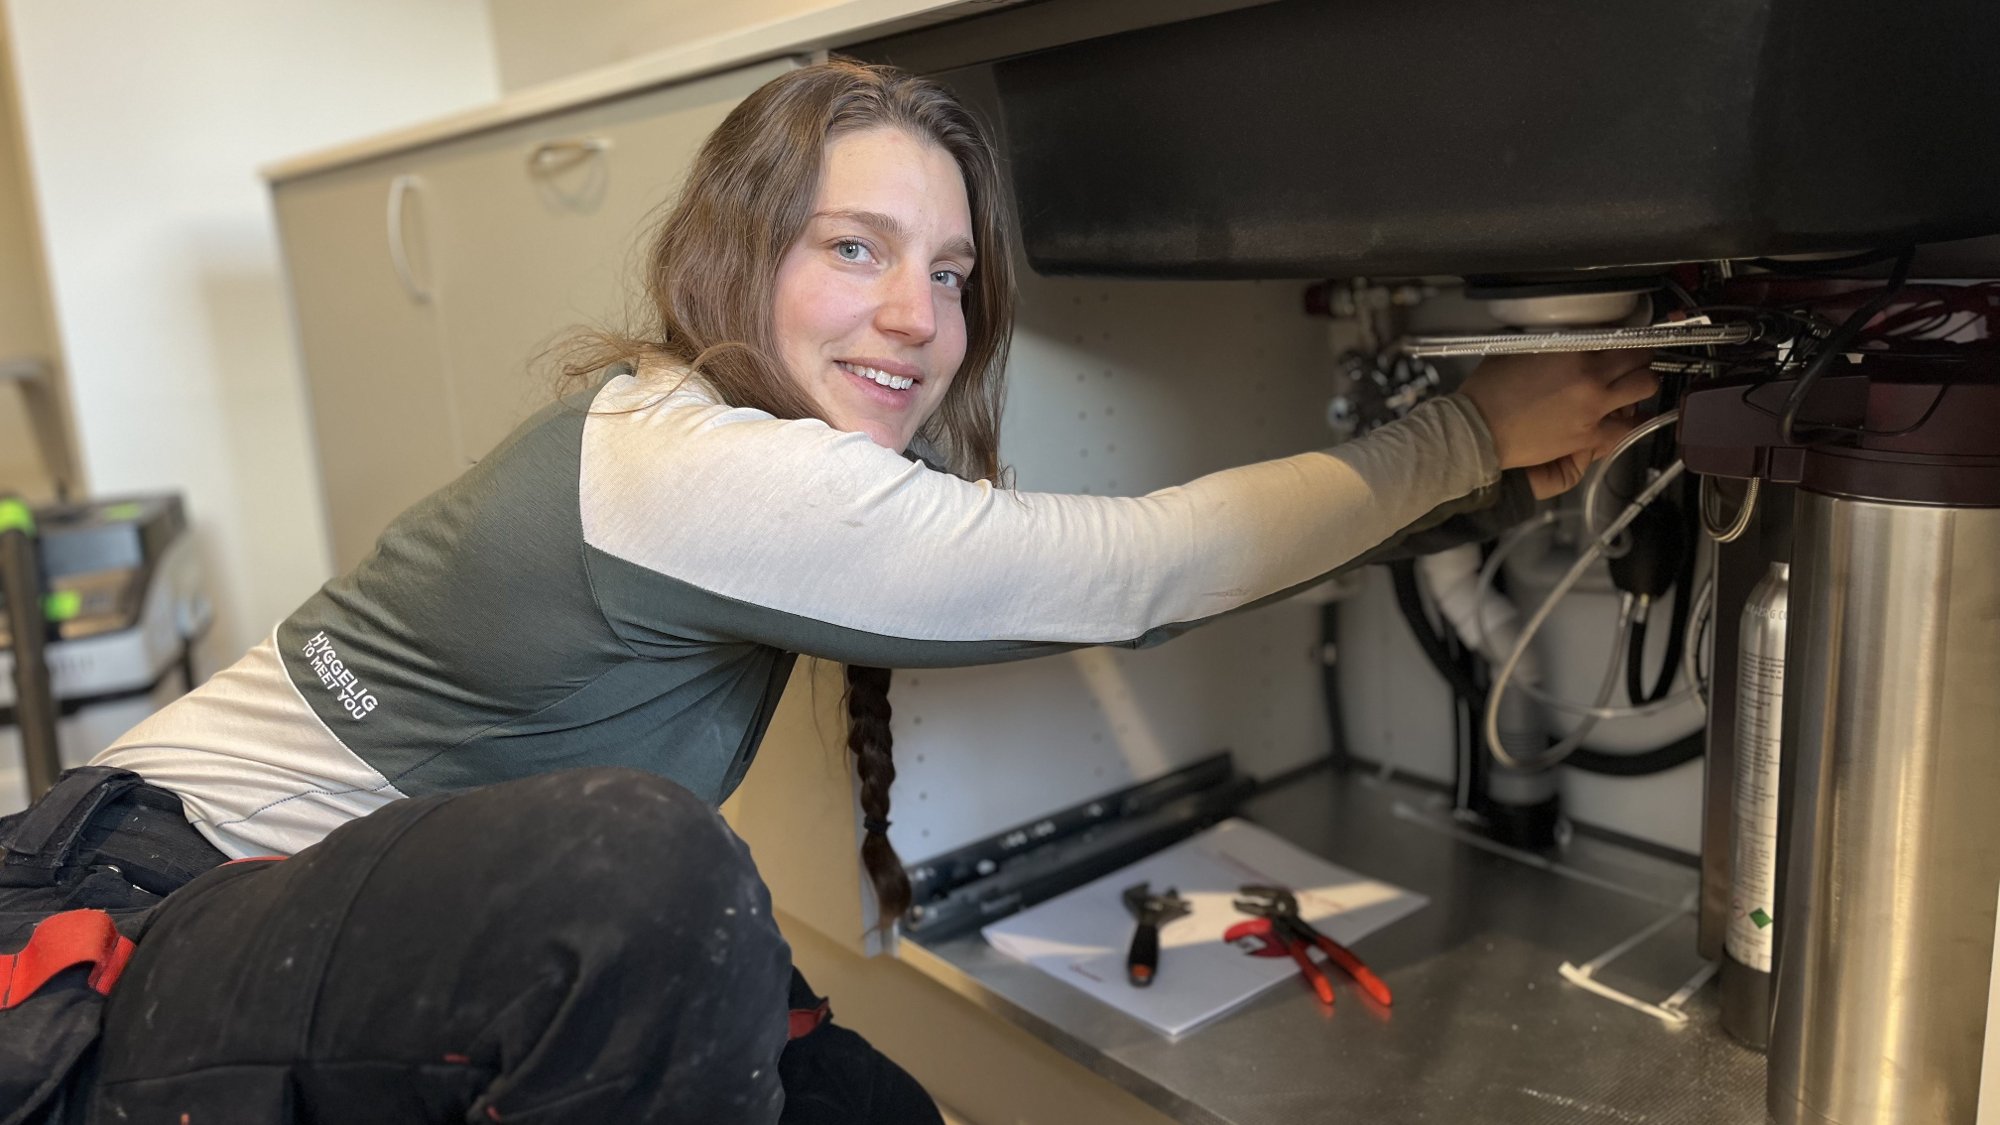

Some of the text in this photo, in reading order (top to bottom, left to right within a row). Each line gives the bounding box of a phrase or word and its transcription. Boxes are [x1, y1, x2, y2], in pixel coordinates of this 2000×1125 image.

[302, 640, 367, 720] TO MEET YOU
[310, 631, 379, 712] HYGGELIG
